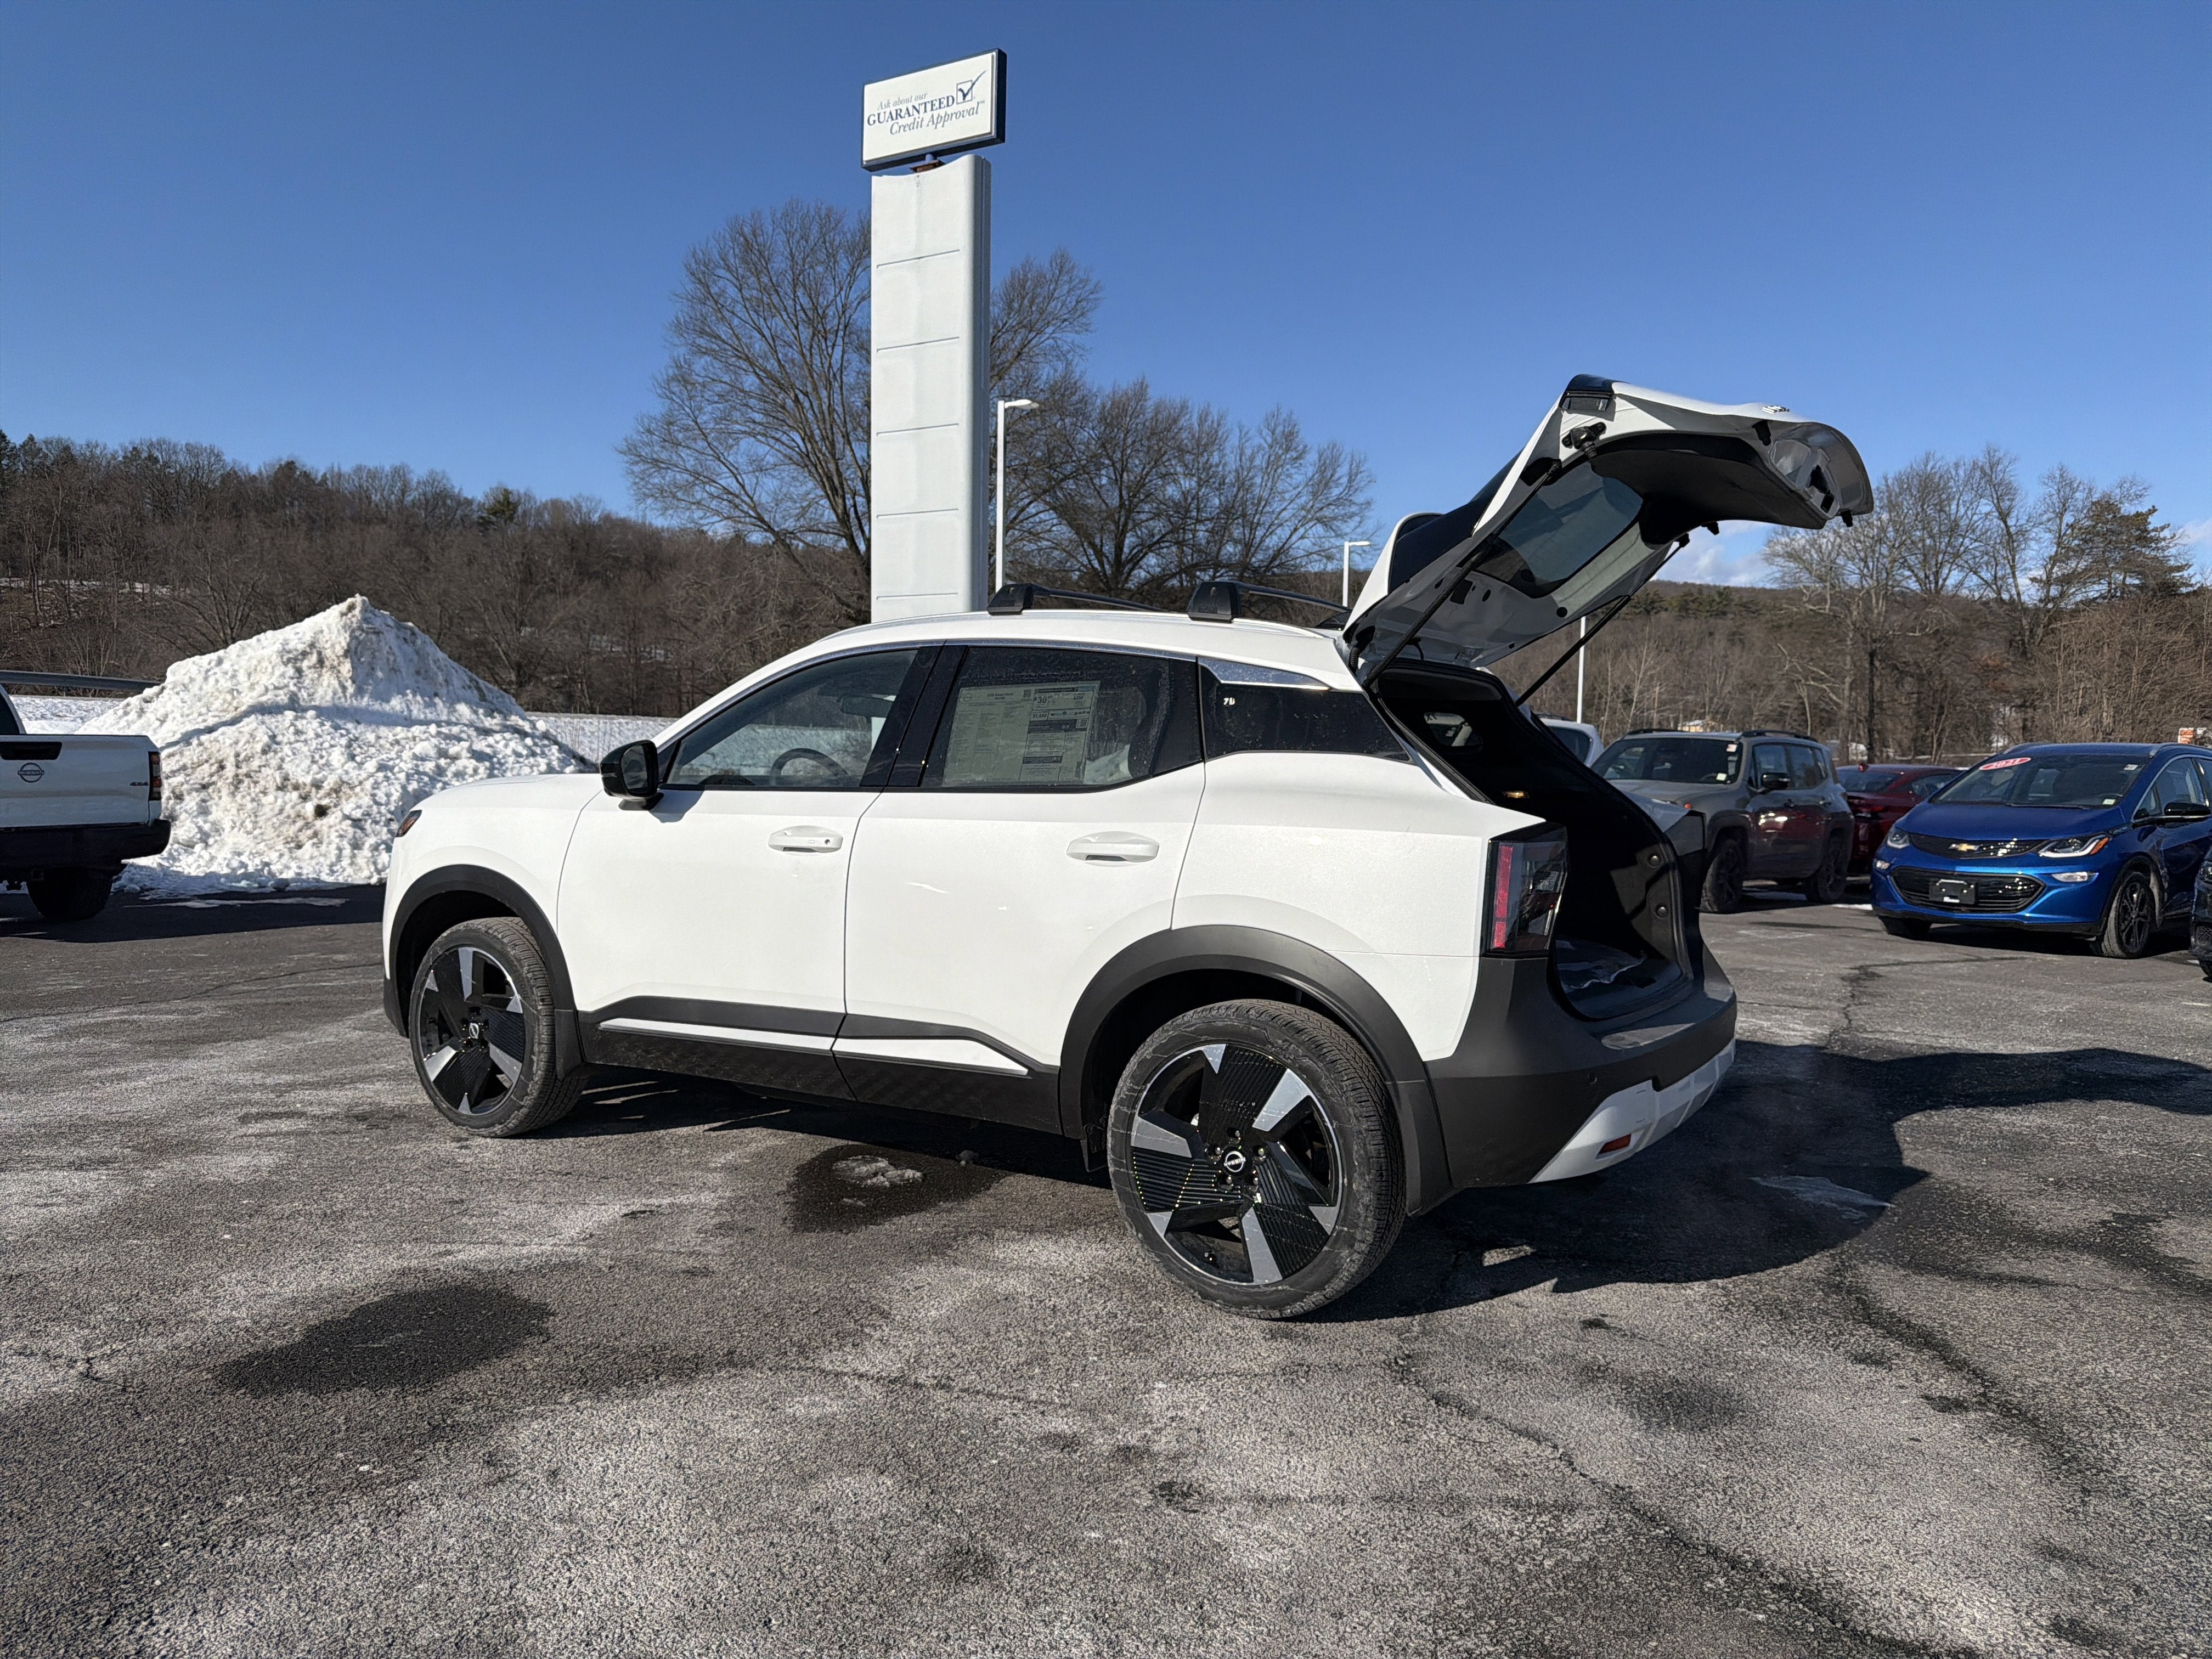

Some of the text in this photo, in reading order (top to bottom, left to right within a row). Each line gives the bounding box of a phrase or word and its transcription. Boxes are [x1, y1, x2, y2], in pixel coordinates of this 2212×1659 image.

[867, 95, 955, 126] GUARANTEED
[877, 93, 928, 110] Ask about our
[889, 116, 925, 135] Credit
